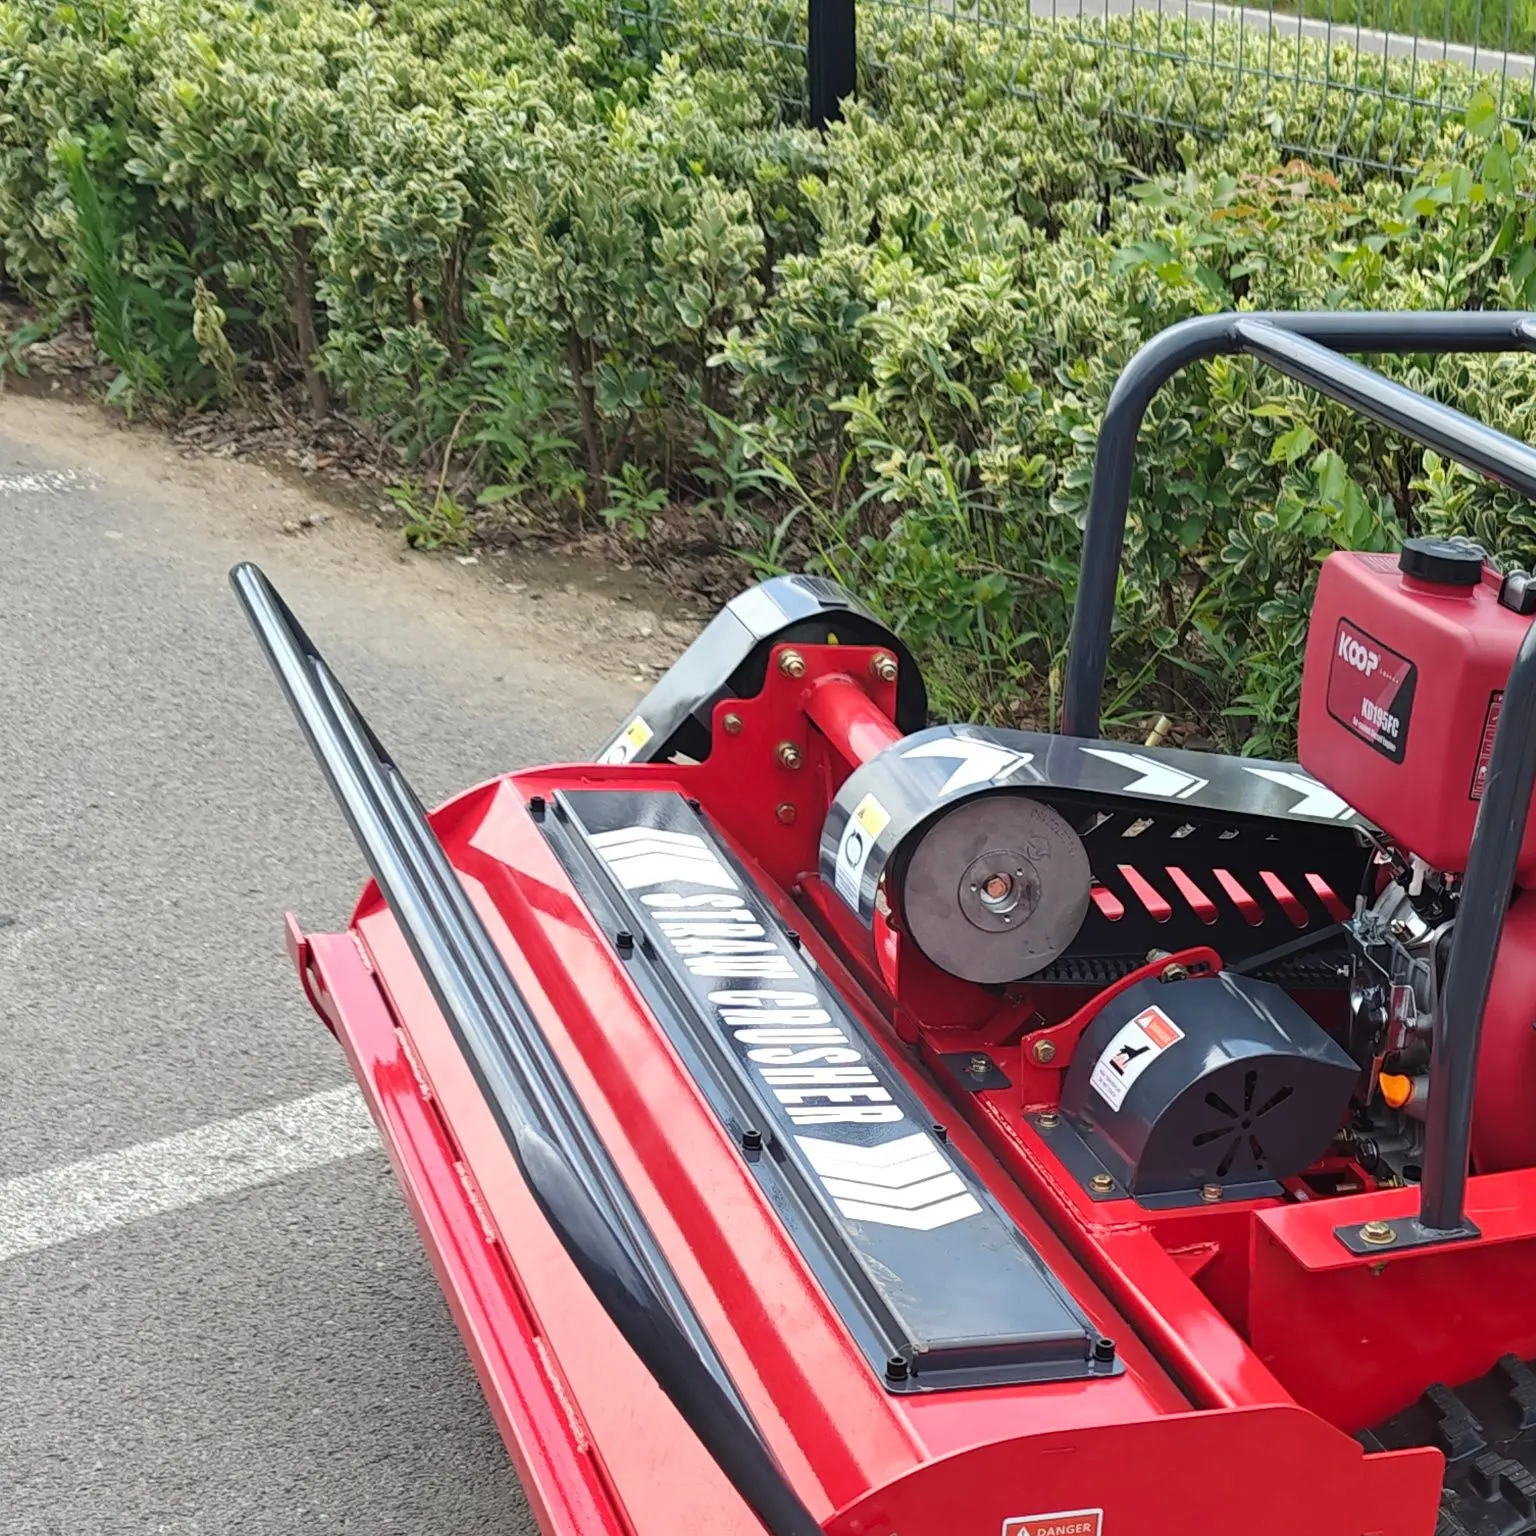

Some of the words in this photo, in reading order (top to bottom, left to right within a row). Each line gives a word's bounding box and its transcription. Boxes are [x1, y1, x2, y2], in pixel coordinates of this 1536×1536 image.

[1338, 631, 1379, 677] KOOP
[1361, 697, 1400, 738] KD195FC
[639, 893, 801, 979] STRAW
[707, 989, 905, 1125] CRUSHER
